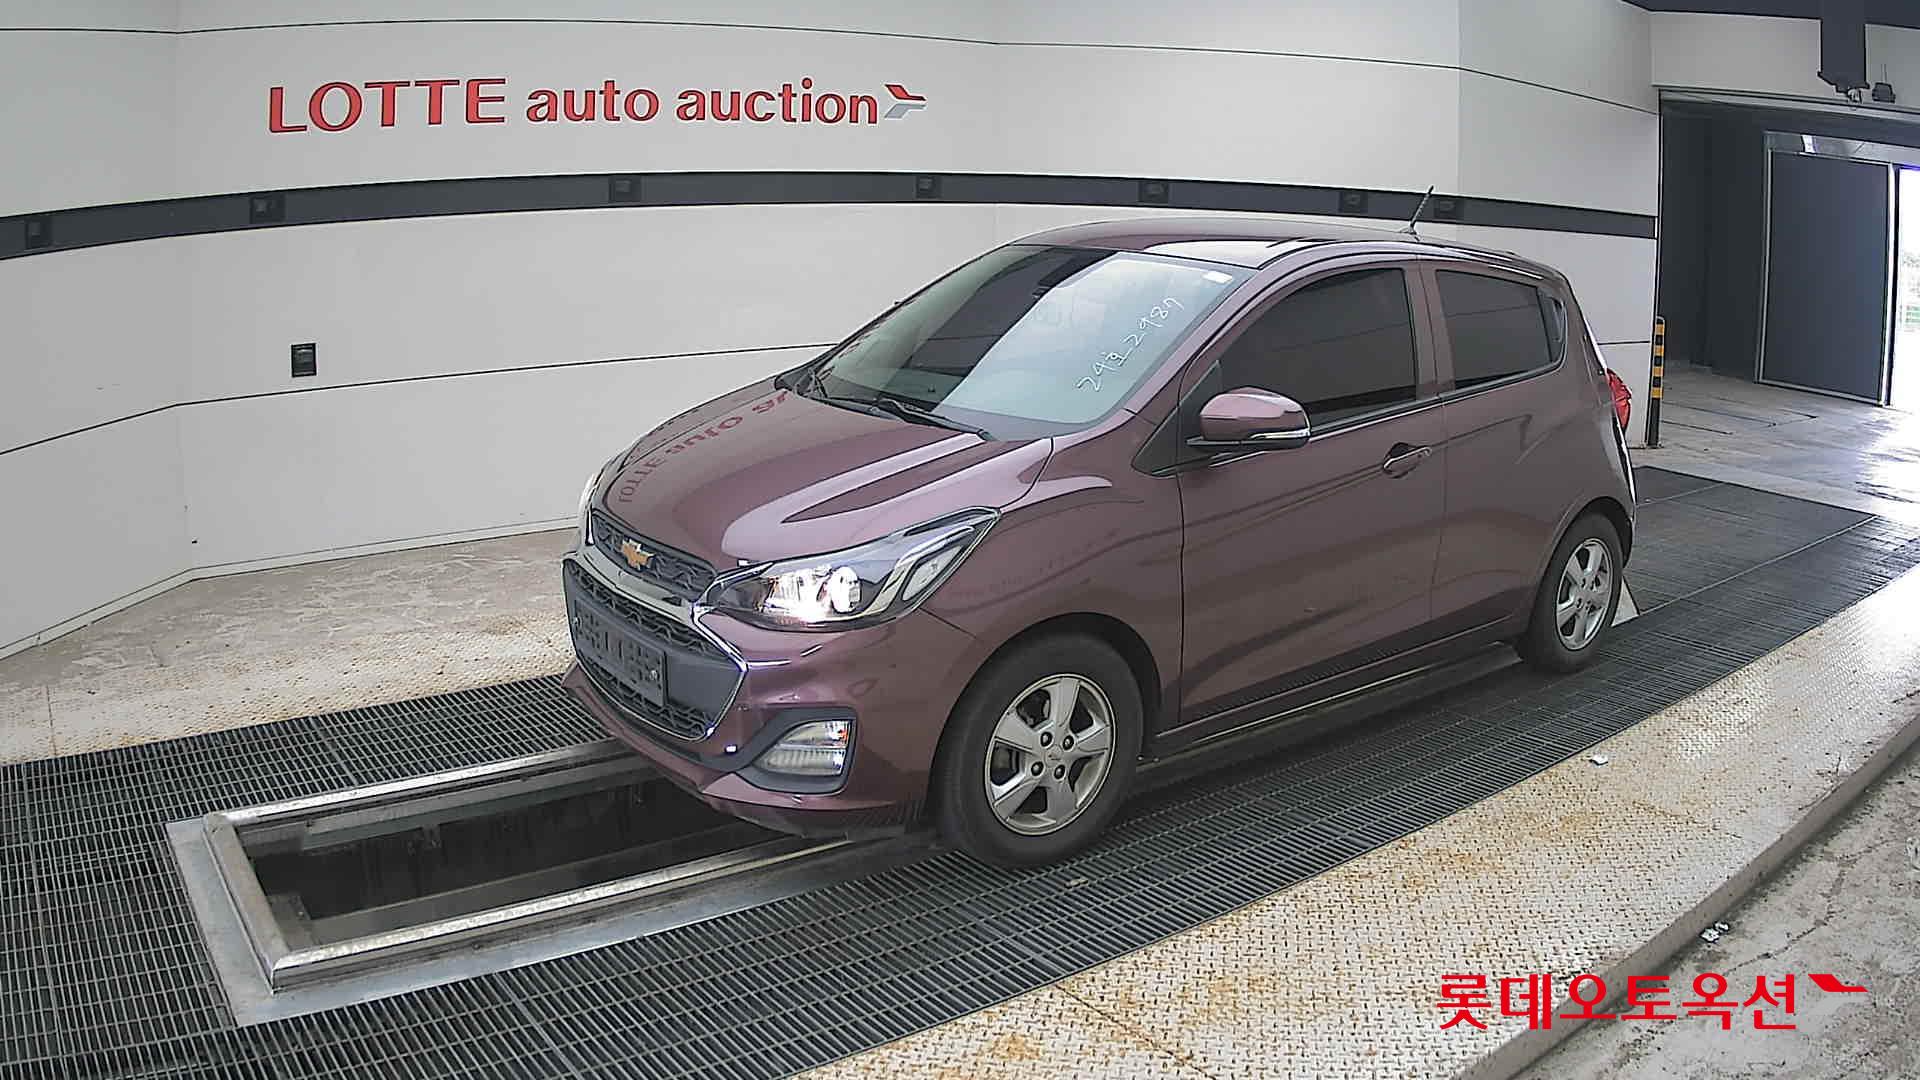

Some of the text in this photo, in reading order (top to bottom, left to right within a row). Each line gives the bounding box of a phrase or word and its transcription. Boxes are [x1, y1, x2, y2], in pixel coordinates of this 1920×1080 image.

[268, 78, 878, 133] LOTTE auto auction
